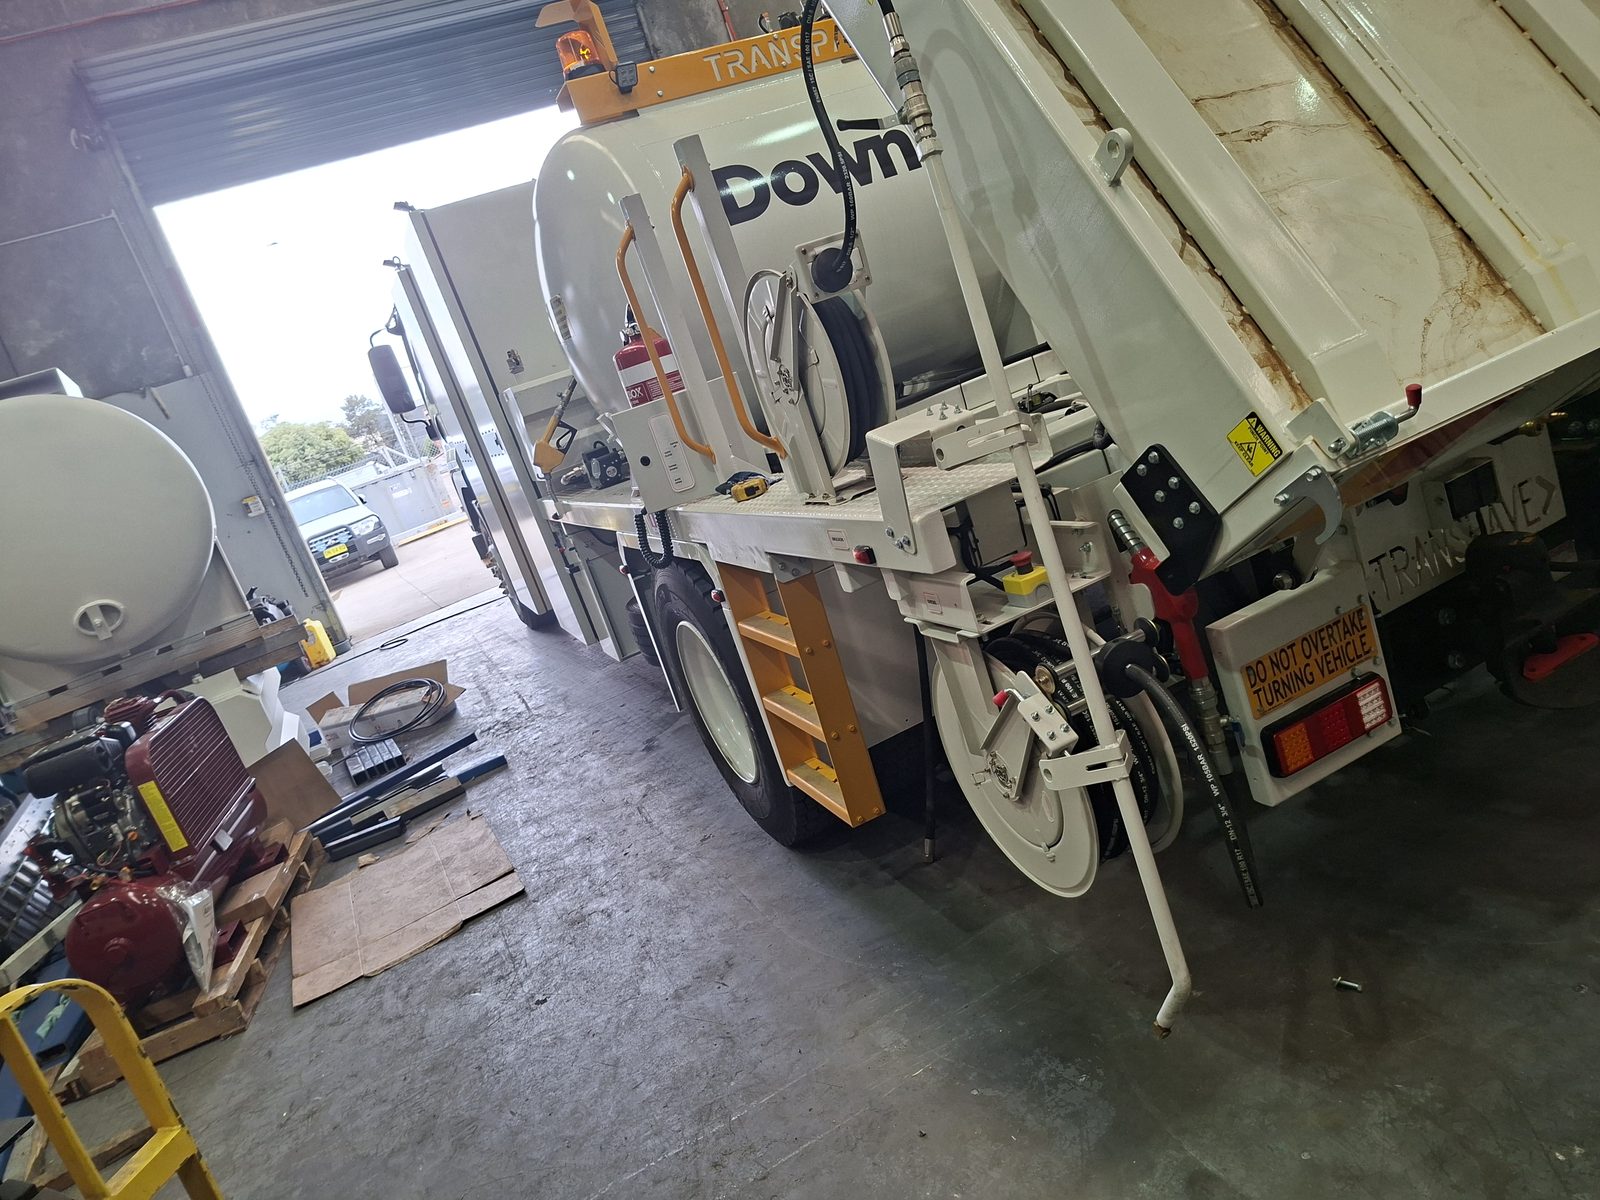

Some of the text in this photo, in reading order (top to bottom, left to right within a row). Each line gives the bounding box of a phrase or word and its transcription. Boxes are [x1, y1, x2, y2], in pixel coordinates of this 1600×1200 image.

[711, 129, 922, 226] Down
[1234, 440, 1254, 467] KEEP CLEAR
[1248, 426, 1269, 454] PINCH POINT
[1256, 424, 1281, 458] WARNING
[1246, 608, 1367, 689] DO NOT OVERTAKE
[1253, 633, 1372, 712] TURNING VEHICLE
[1181, 723, 1200, 752] 1520PSI
[1197, 753, 1214, 782] 105BAR
[1210, 784, 1220, 796] WP
[1224, 820, 1237, 840] DN-12
[1235, 848, 1244, 860] R17
